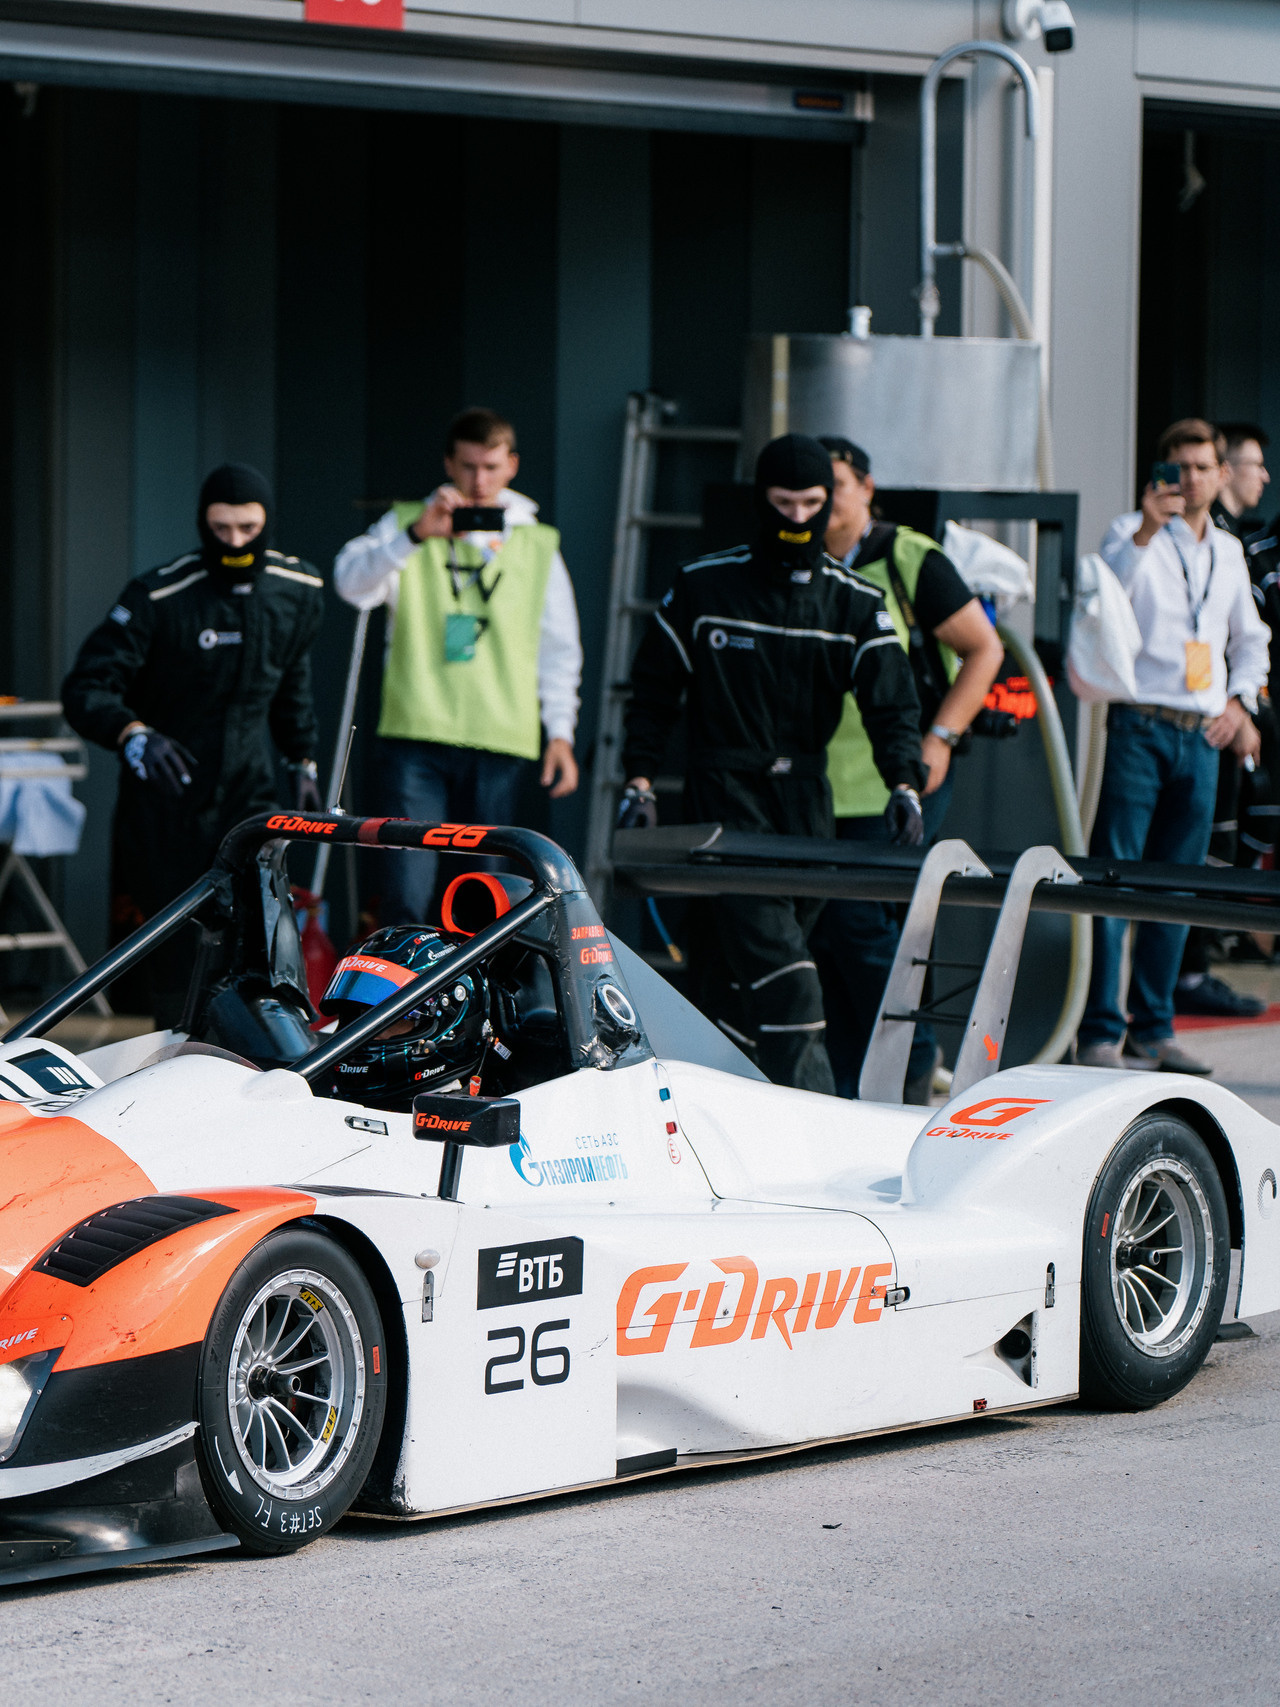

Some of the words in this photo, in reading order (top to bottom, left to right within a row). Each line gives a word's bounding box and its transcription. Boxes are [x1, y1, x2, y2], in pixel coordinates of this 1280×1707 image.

[266, 814, 338, 835] G-DRIVE
[422, 822, 499, 848] 26
[414, 1064, 446, 1081] G-DRIVE
[415, 1112, 472, 1132] G-DRIVE
[926, 1126, 1014, 1140] G-DRIVE
[575, 1136, 600, 1150] СЕТЬ
[602, 1133, 619, 1147] АЗС
[541, 1153, 628, 1186] ГАЗПРОМНЕФТЬ
[518, 1253, 564, 1293] ВТБ
[300, 1290, 324, 1312] ATS
[616, 1255, 893, 1357] G-DRIVE
[485, 1318, 570, 1395] 26
[322, 1406, 337, 1444] ATS
[254, 1493, 273, 1528] FL
